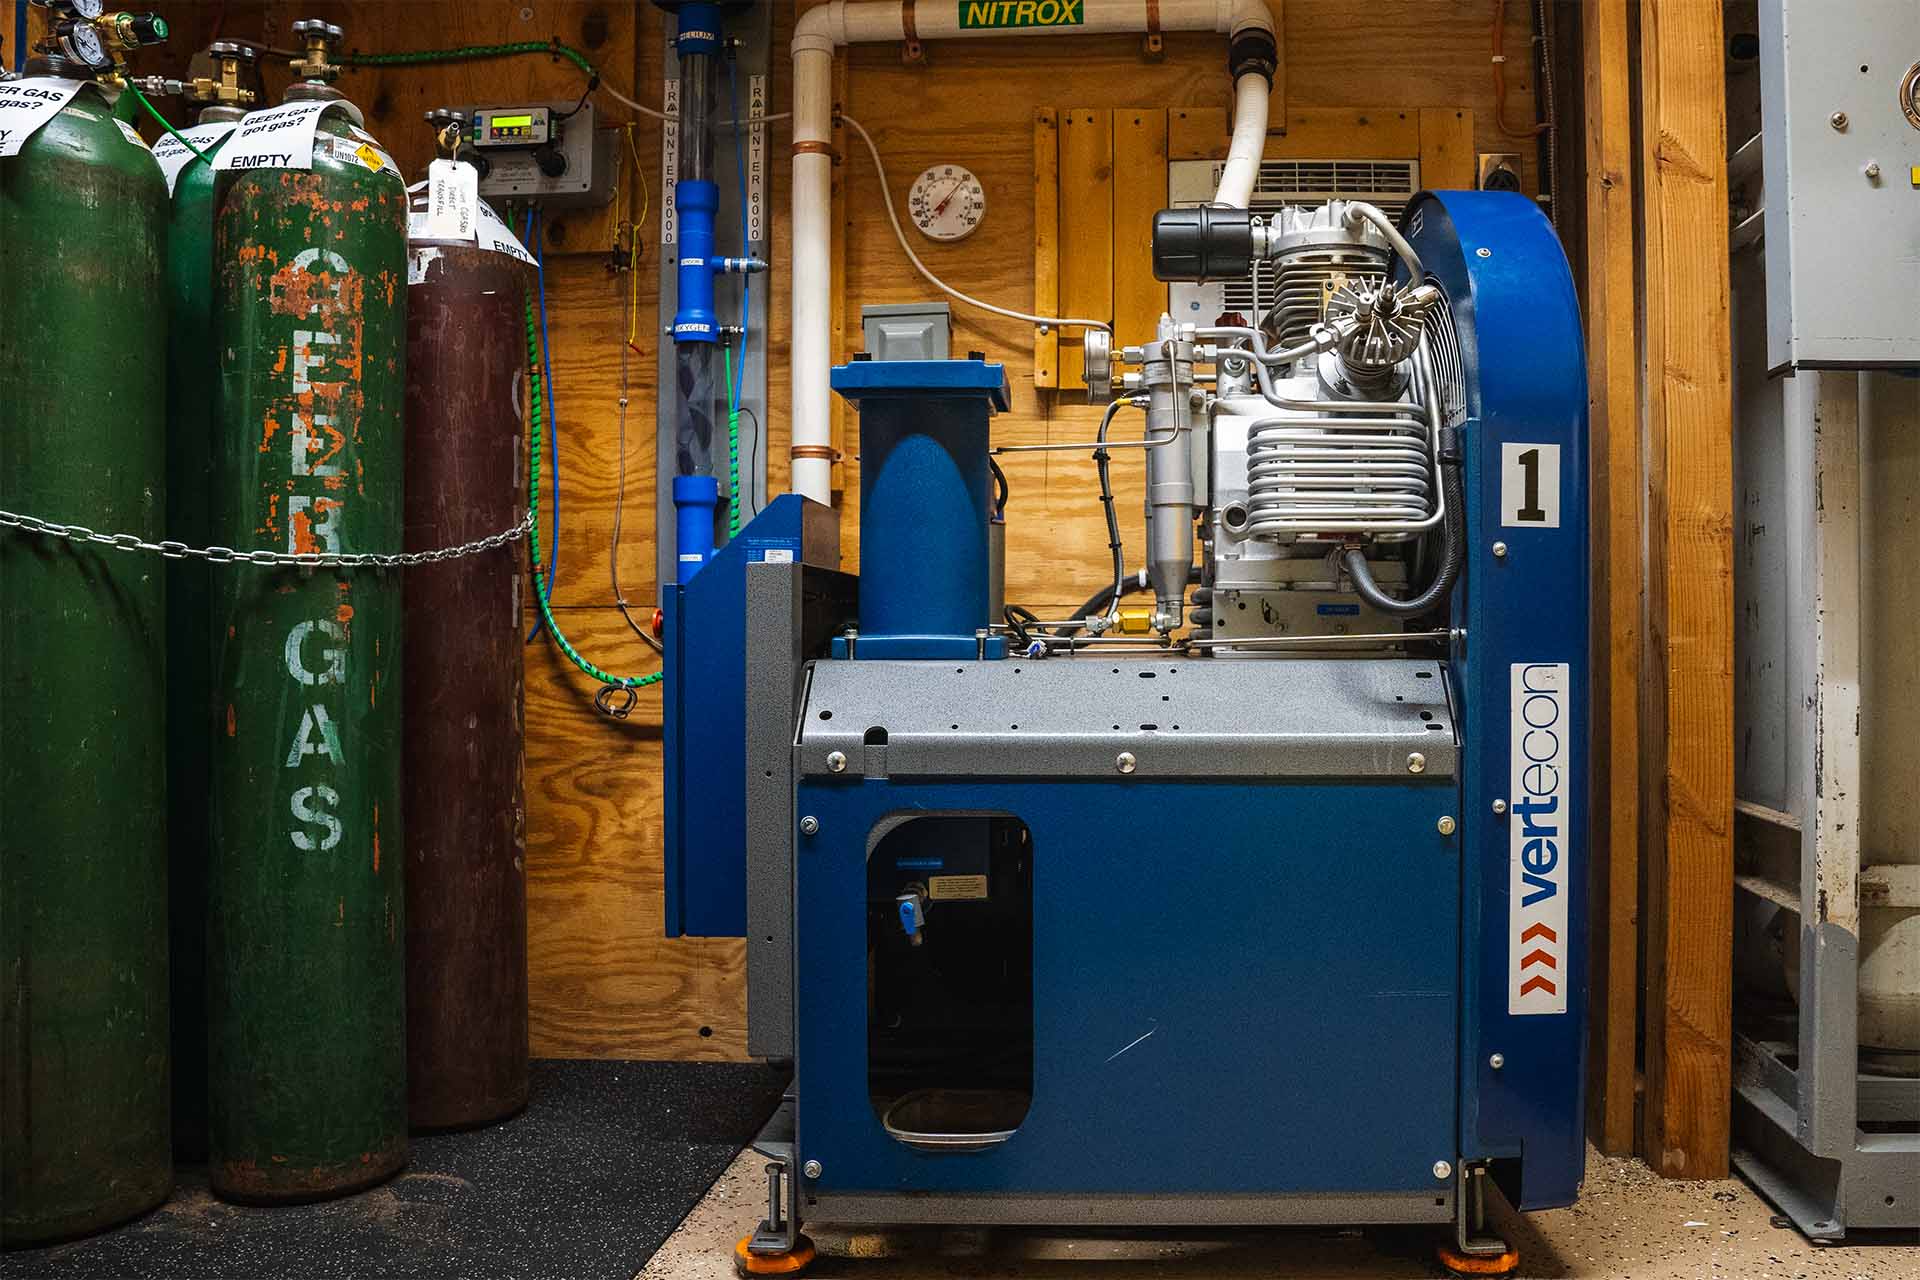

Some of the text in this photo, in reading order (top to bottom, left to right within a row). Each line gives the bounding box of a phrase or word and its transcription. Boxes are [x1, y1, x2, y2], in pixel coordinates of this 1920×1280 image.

[966, 0, 1080, 26] NITROX
[23, 88, 64, 102] GAS
[241, 117, 306, 137] got gas?
[244, 105, 321, 126] GEER GAS
[230, 153, 292, 168] EMPTY
[334, 150, 359, 164] UN1072
[665, 195, 674, 243] 6000
[751, 192, 760, 240] 6000
[493, 240, 529, 262] EMPTY
[1517, 448, 1546, 521] 1
[284, 618, 347, 851] GAS
[1511, 663, 1560, 909] vertecon
